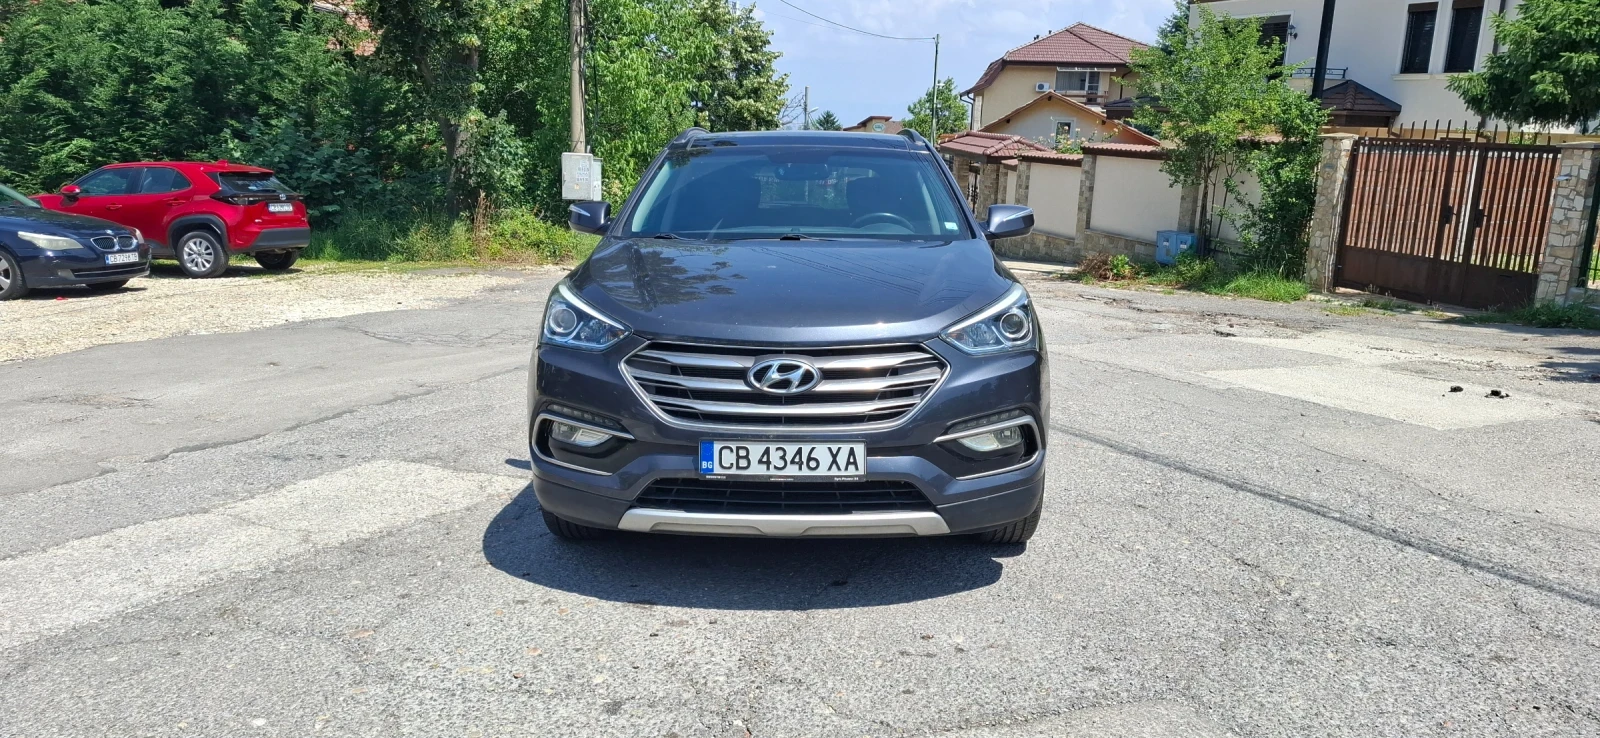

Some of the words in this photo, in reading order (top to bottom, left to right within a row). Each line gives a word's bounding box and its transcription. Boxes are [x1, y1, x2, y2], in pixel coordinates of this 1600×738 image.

[702, 461, 713, 469] BG
[718, 445, 751, 470] CB
[757, 446, 820, 471] 4346
[827, 446, 859, 471] XA
